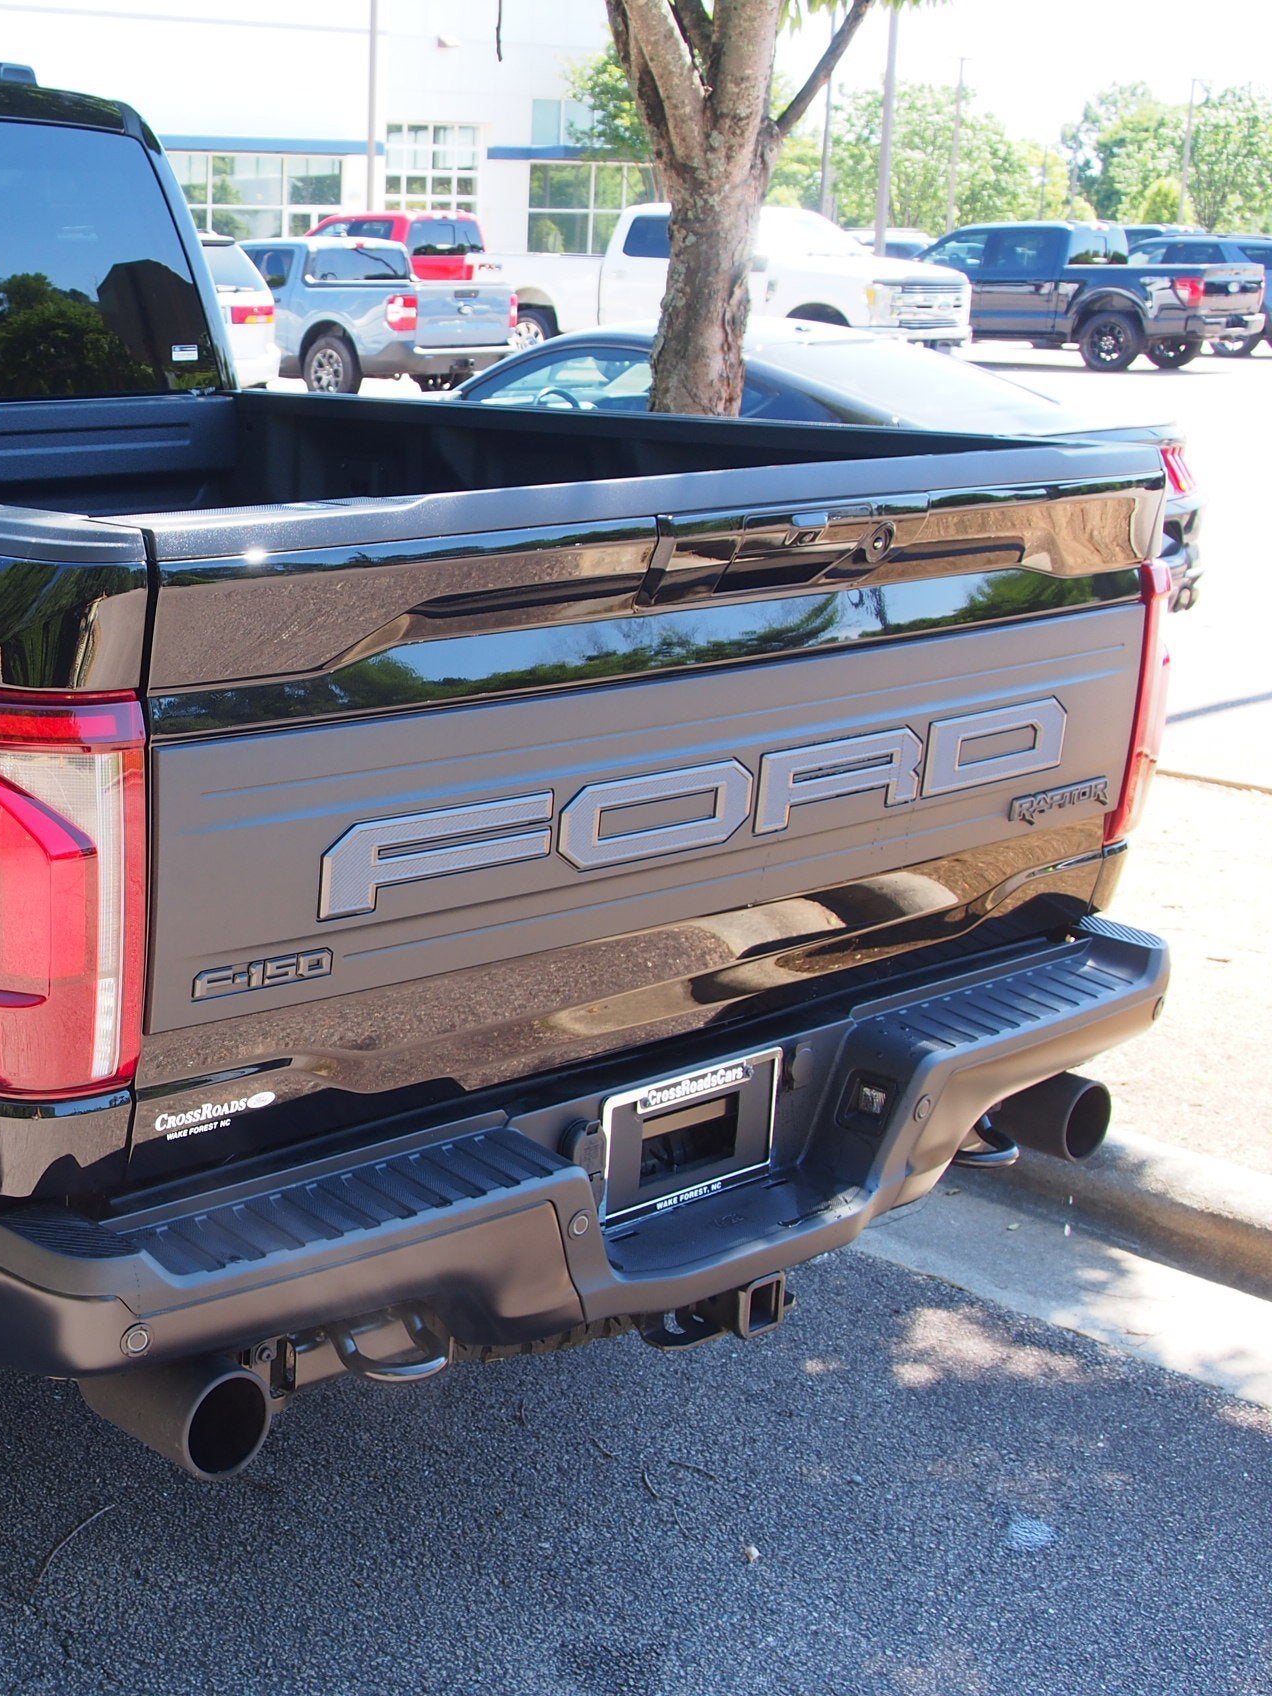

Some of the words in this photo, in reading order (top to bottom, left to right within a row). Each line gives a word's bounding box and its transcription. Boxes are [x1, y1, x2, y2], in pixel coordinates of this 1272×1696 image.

[316, 696, 1067, 922] FORD
[1008, 775, 1108, 826] RAPTOR
[191, 947, 333, 1000] F-150
[647, 1065, 743, 1106] CrossRoadsCars
[166, 1129, 188, 1141] WAKE
[190, 1121, 218, 1135] FOREST
[219, 1118, 232, 1128] NC
[656, 1197, 678, 1210] WAKE
[679, 1186, 710, 1202] FOREST,
[711, 1181, 722, 1192] NC
